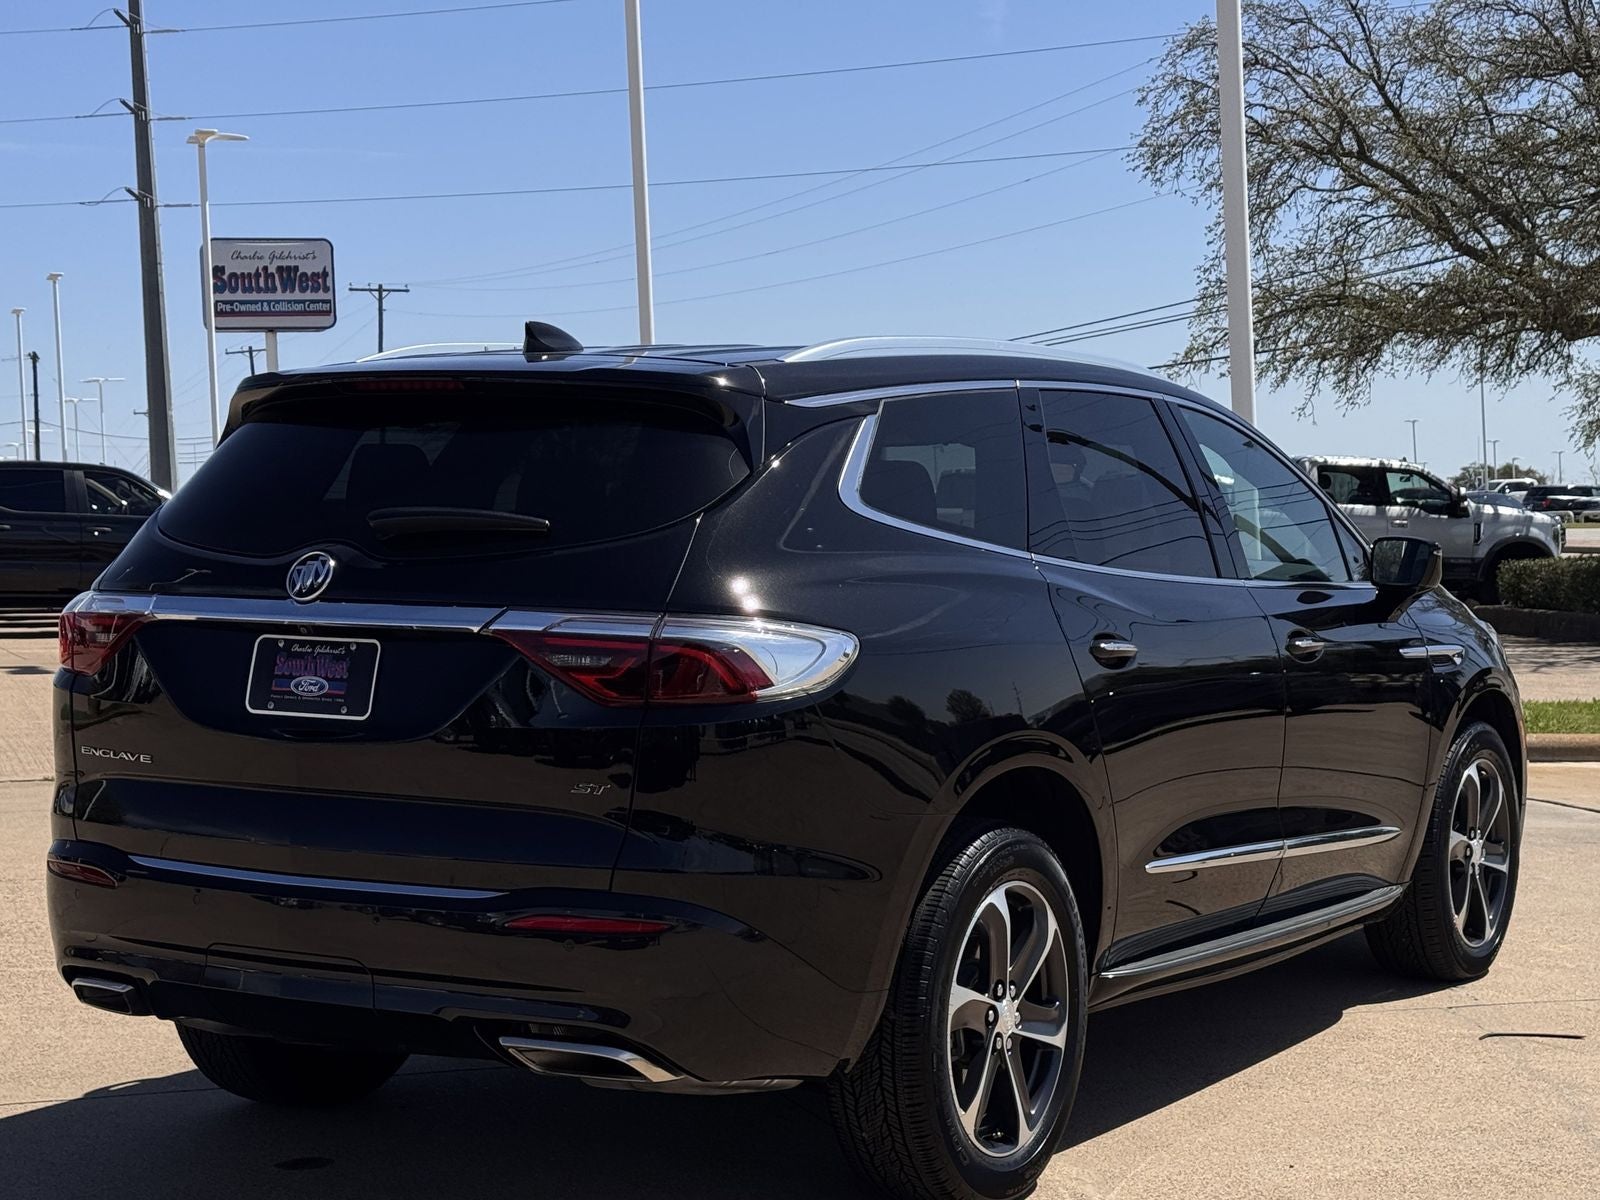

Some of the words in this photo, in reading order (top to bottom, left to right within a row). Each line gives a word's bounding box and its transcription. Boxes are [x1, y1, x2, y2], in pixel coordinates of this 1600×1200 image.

[231, 250, 264, 260] Charlie
[217, 302, 261, 312] Pre-Owned
[262, 302, 269, 312] &
[270, 302, 305, 312] Collision
[305, 302, 331, 312] Center
[298, 680, 320, 692] Ford
[81, 745, 152, 763] ENCLAVE
[570, 783, 611, 795] ST
